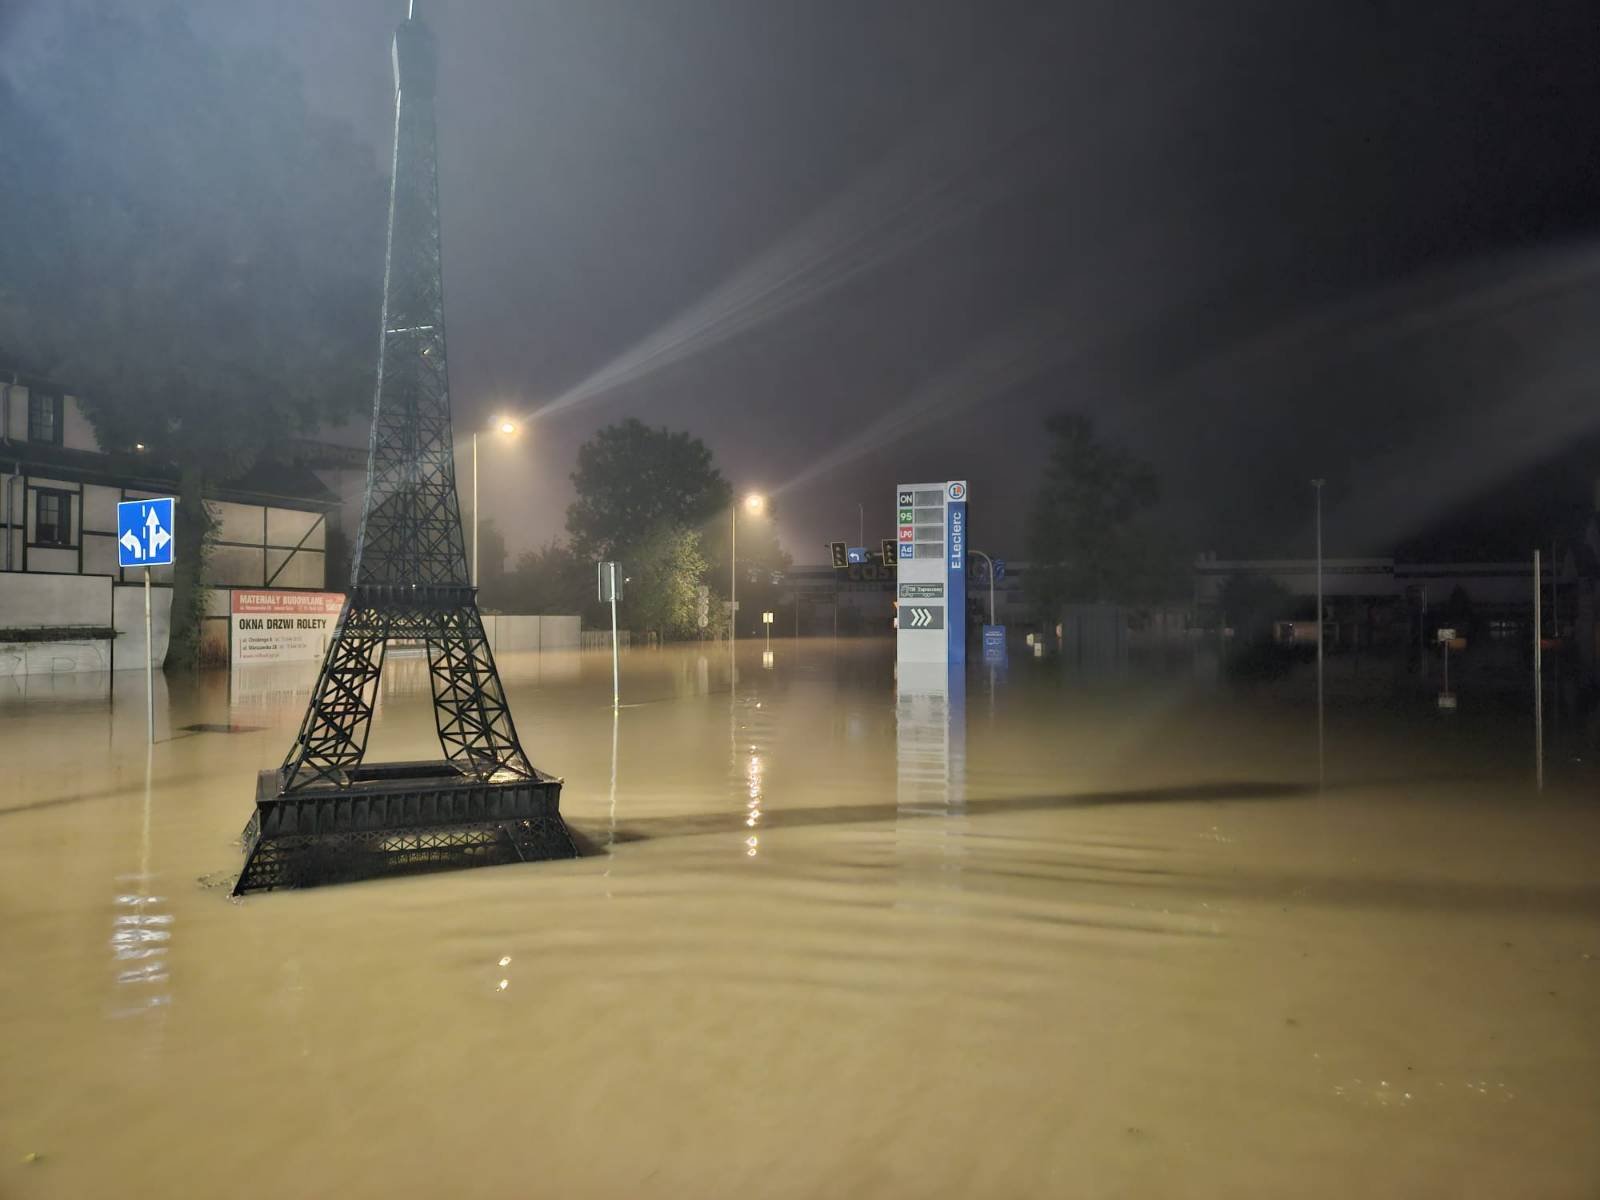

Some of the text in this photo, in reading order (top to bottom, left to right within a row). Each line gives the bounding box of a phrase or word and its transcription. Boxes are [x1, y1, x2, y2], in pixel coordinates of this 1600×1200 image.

[900, 495, 912, 504] ON
[901, 512, 912, 521] 95
[900, 530, 913, 538] LPG
[239, 618, 327, 630] OKNA DRZWI ROLETY
